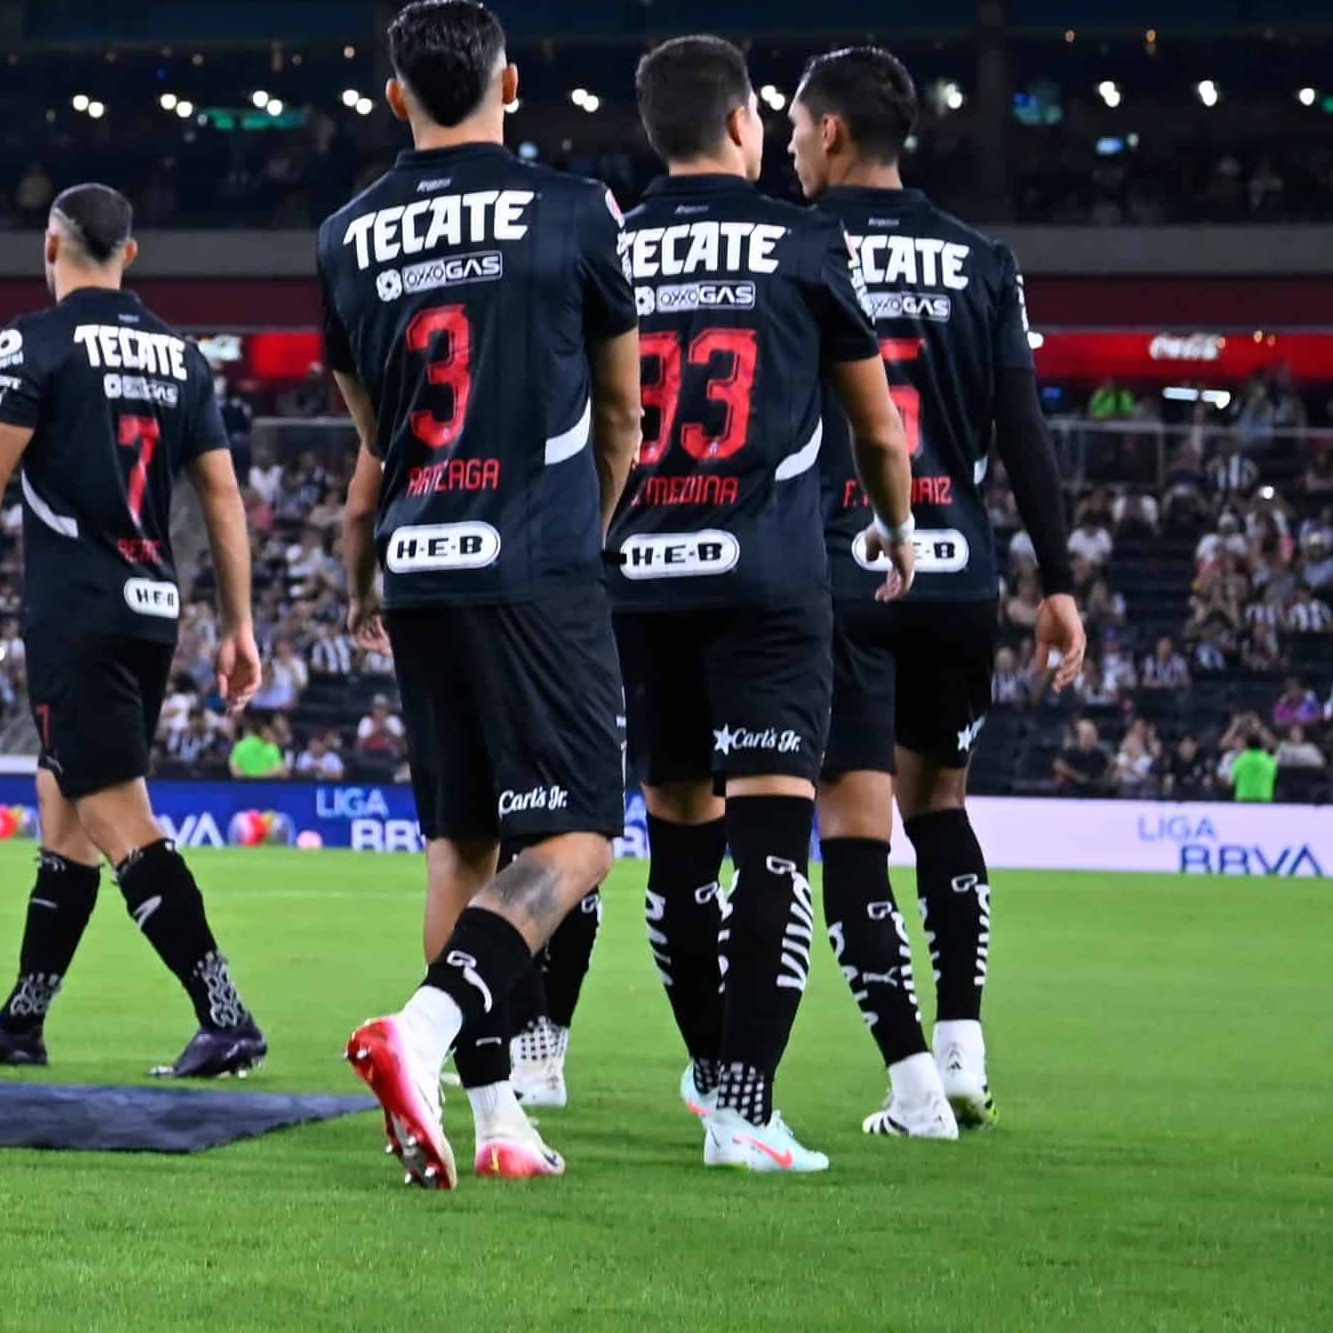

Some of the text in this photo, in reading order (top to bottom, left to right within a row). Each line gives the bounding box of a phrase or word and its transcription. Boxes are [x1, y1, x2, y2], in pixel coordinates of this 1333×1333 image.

[343, 191, 534, 270] TECATE
[445, 256, 500, 279] GAS
[851, 234, 971, 291] CATE
[699, 286, 754, 305] GAS
[902, 300, 950, 318] GAS
[74, 324, 188, 380] TECATE
[406, 304, 472, 449] 3
[118, 414, 160, 524] 7
[733, 728, 801, 753] Carl's Jr.
[316, 787, 388, 818] LIGA
[499, 786, 568, 818] Carl's Jr.
[1138, 816, 1217, 842] LIGA
[1181, 842, 1323, 877] BBVA
